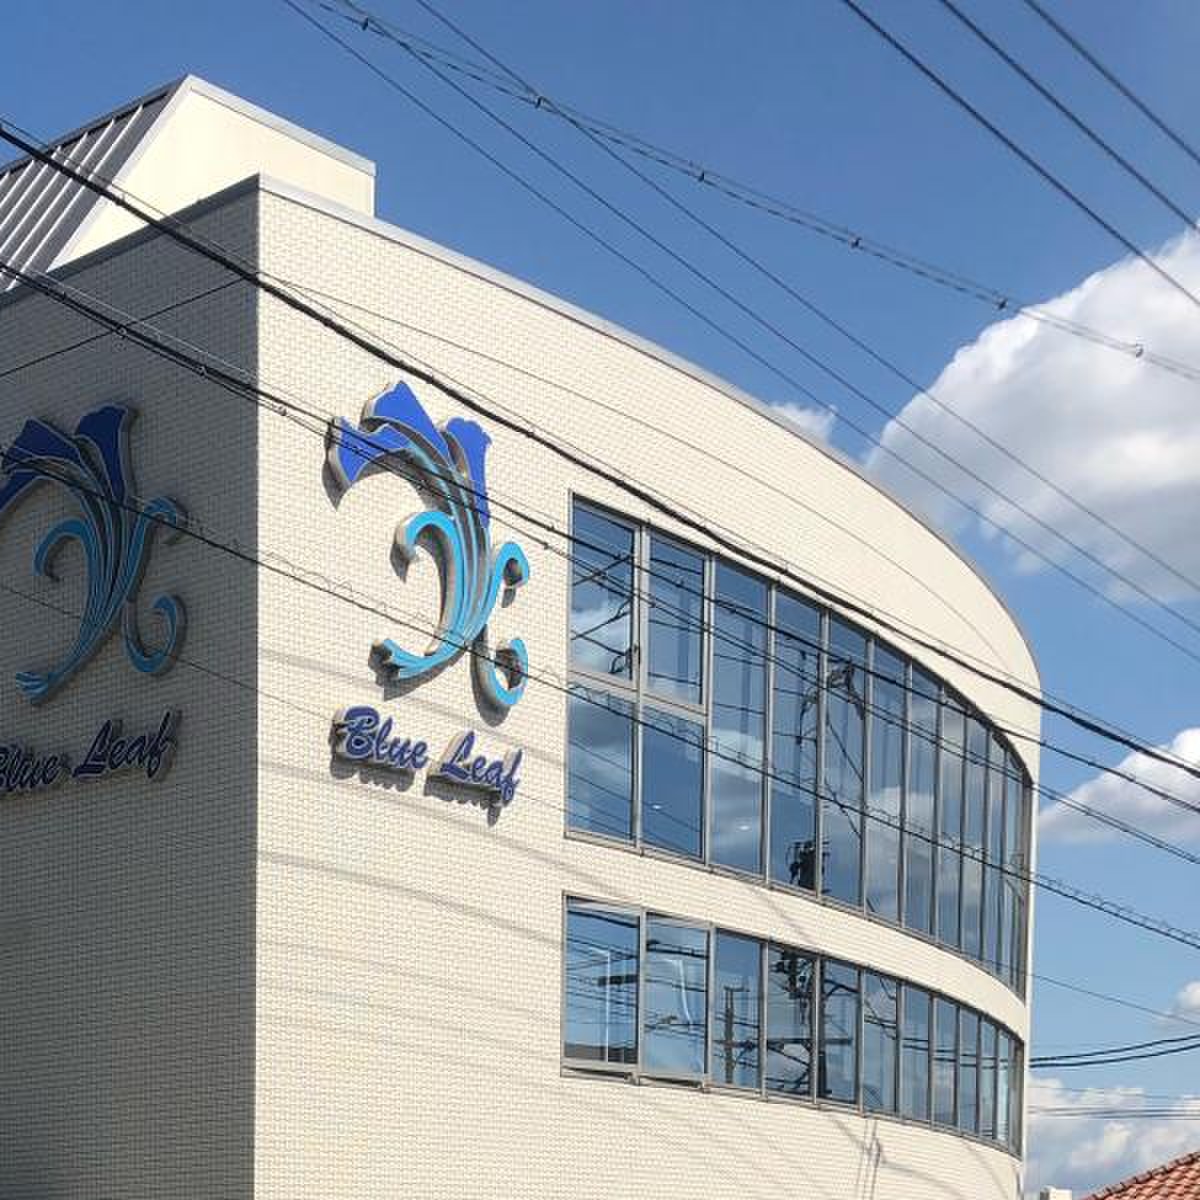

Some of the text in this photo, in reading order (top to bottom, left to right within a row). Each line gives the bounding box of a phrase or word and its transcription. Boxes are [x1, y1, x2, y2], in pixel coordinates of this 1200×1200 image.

[72, 711, 173, 778] Leaf
[344, 705, 523, 807] Blue Leaf
